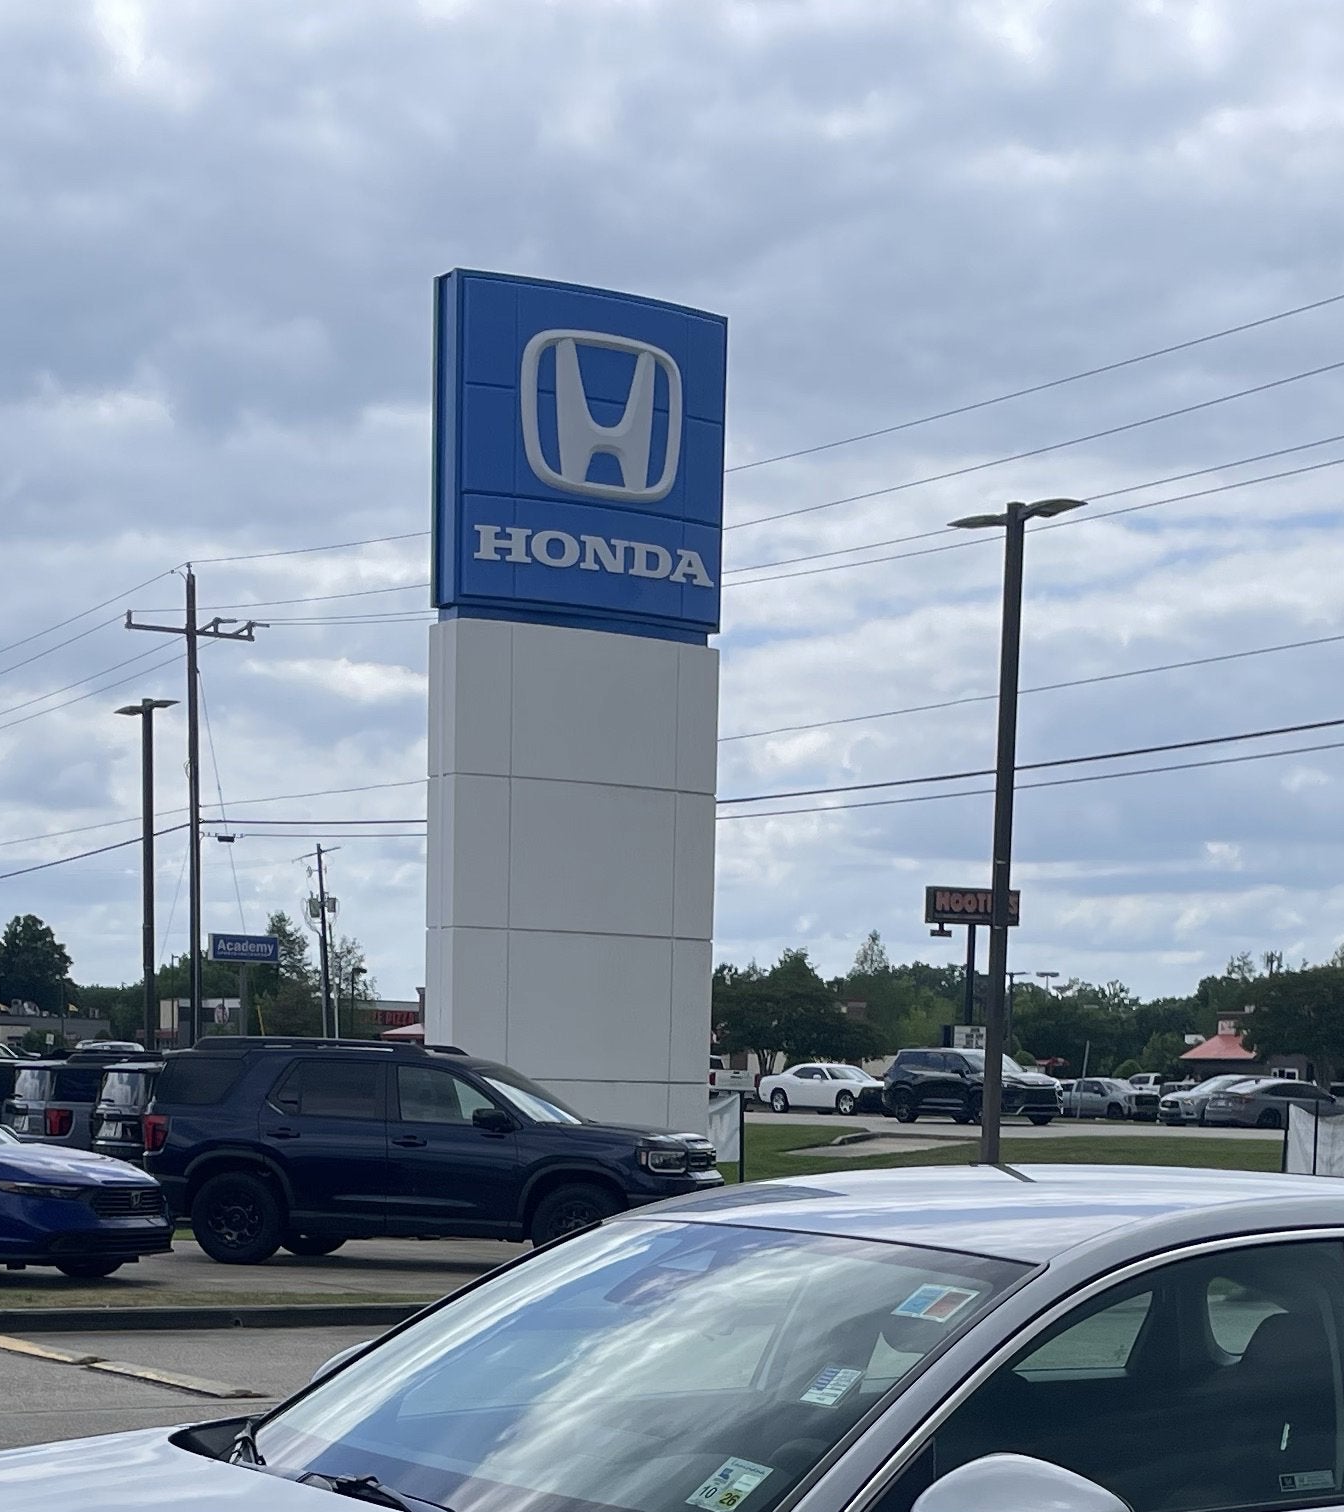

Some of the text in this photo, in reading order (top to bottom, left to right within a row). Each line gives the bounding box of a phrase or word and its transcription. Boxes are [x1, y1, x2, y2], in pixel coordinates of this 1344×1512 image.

[473, 524, 714, 588] HONDA
[217, 939, 274, 957] Academy
[699, 1486, 718, 1499] 10
[719, 1492, 741, 1507] 26
